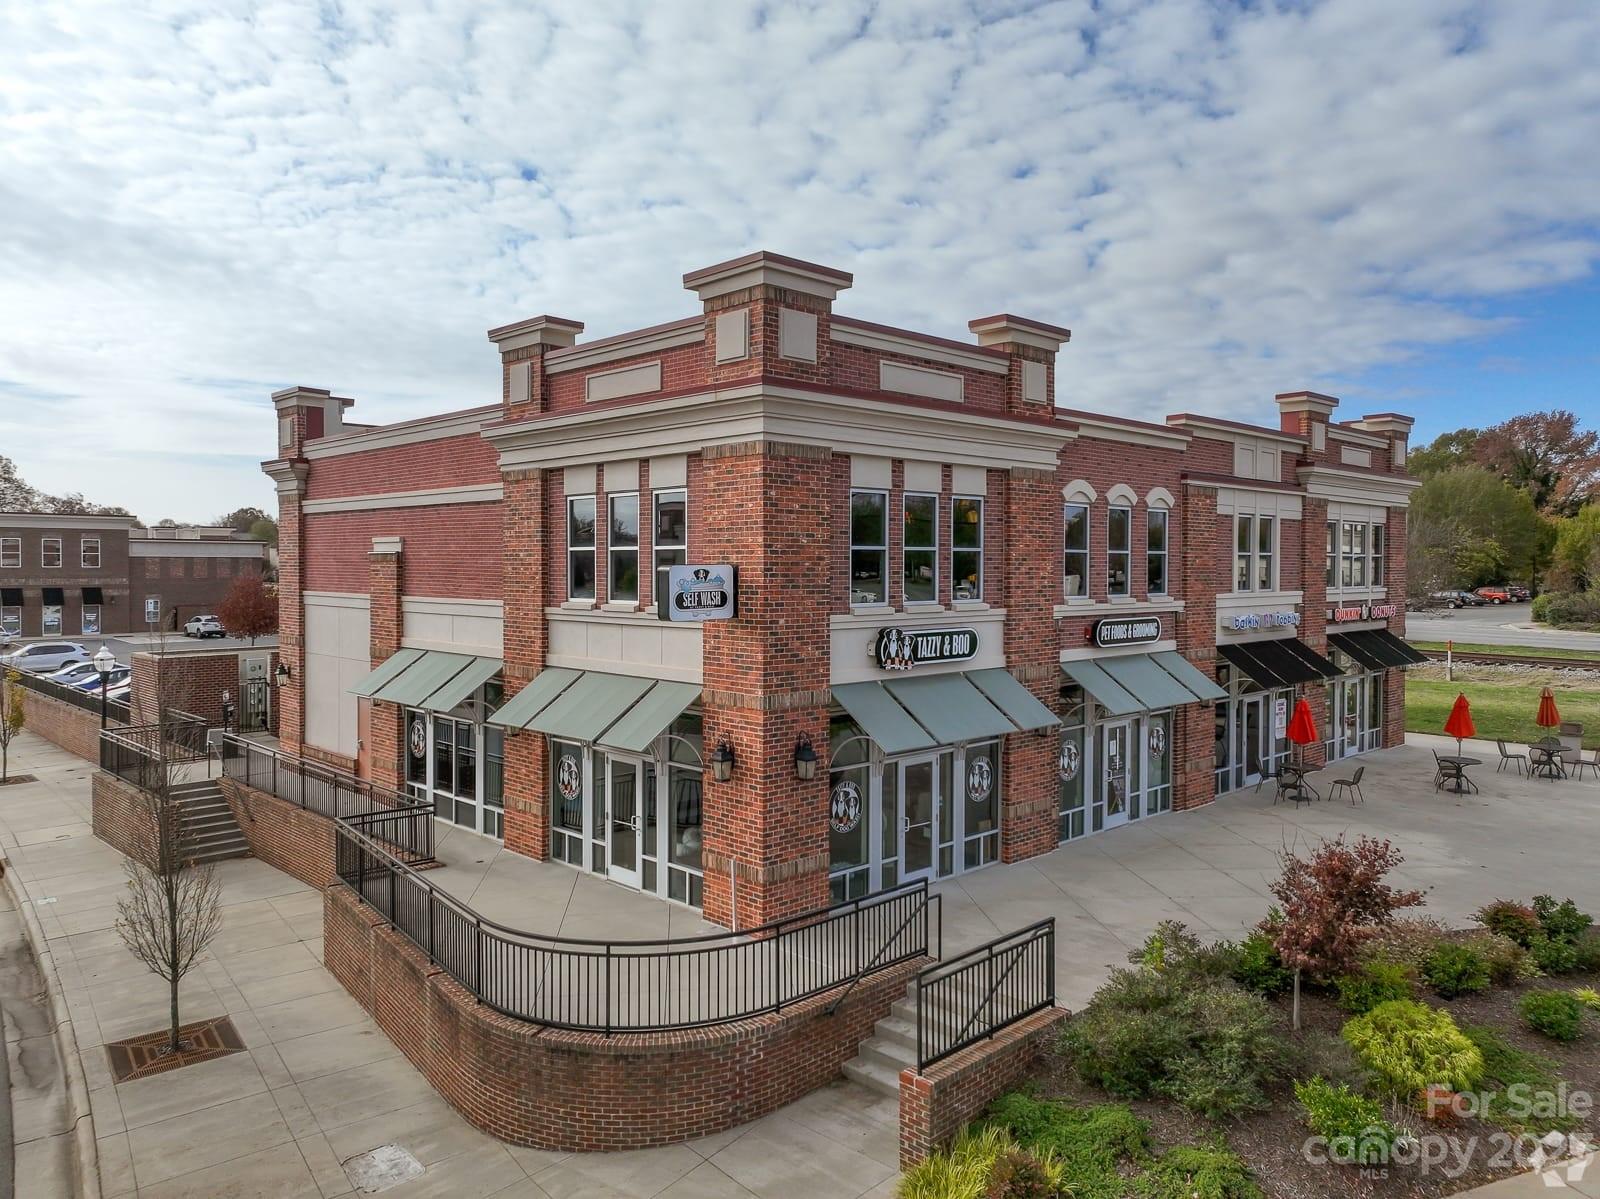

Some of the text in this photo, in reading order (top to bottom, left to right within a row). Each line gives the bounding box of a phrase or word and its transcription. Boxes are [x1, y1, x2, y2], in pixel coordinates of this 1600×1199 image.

[683, 591, 721, 607] SELF WASH
[1101, 622, 1158, 640] PET FOODS & GROOMING
[917, 633, 970, 658] TAZZY & BOO
